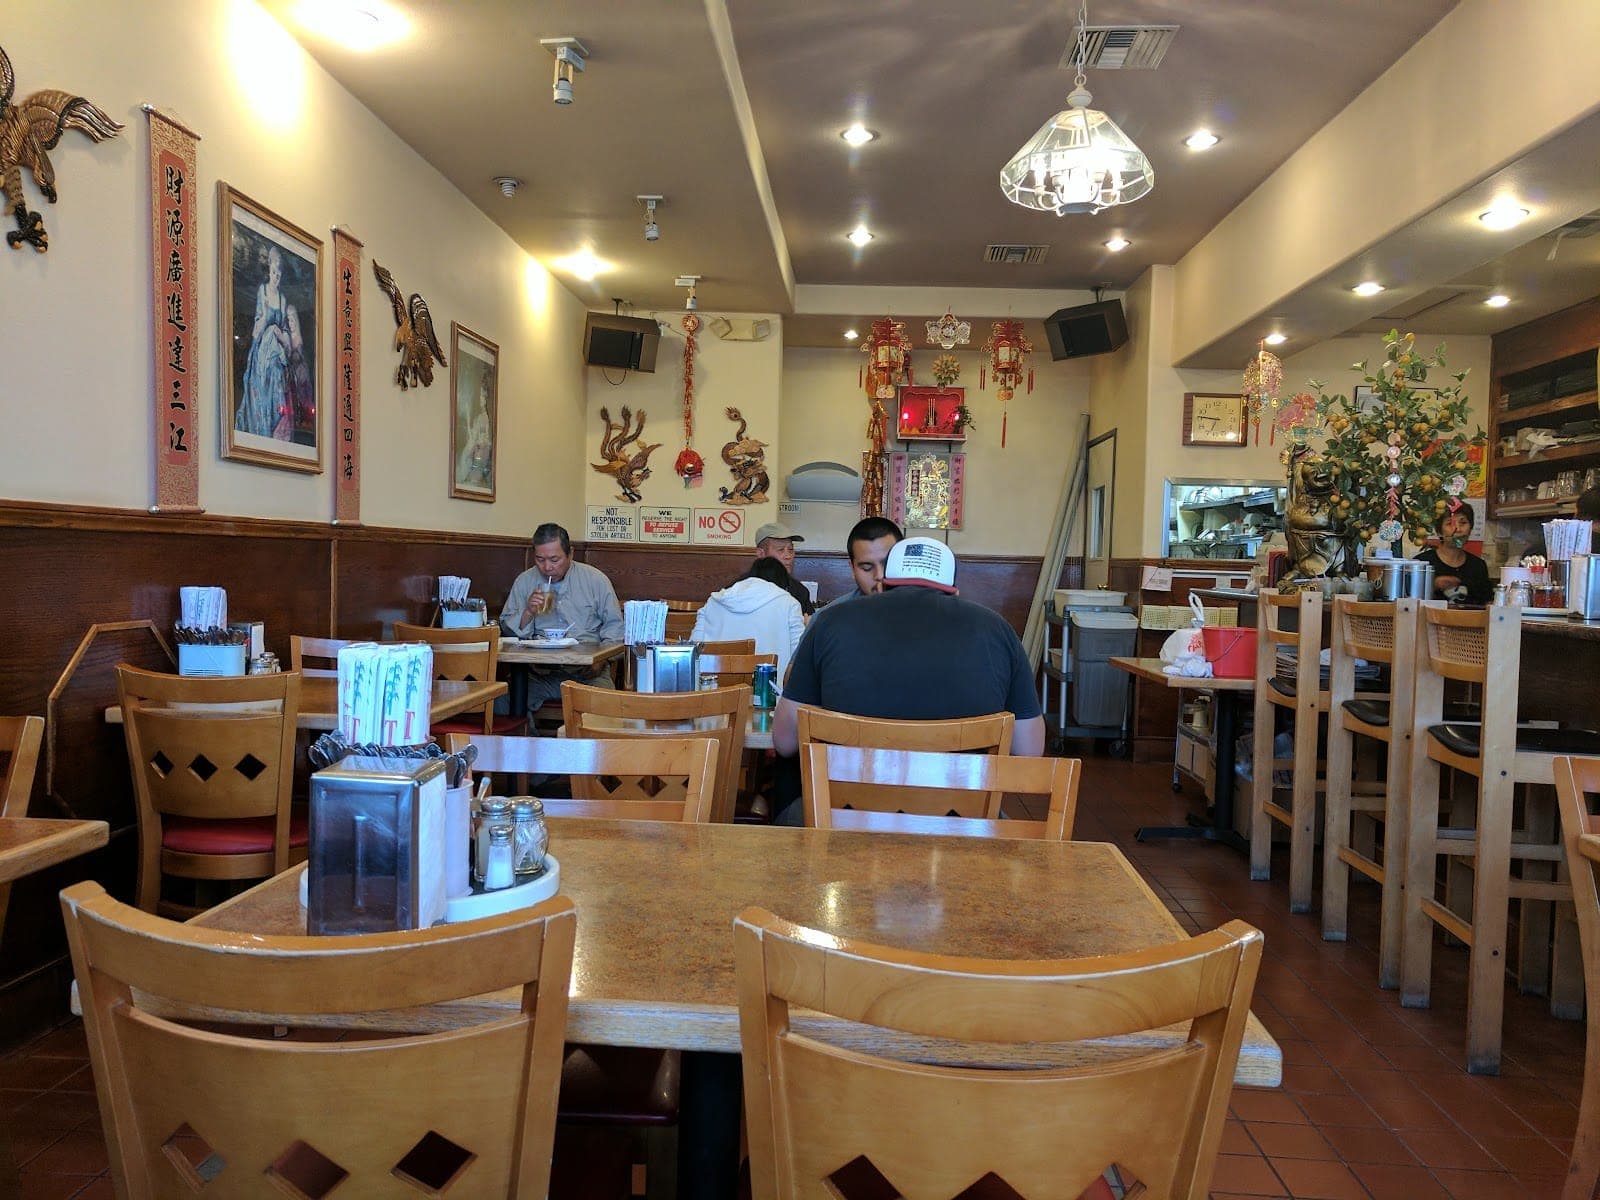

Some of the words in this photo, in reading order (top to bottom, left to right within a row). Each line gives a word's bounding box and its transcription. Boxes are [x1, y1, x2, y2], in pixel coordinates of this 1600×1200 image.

[605, 507, 618, 516] NOT
[591, 516, 633, 526] RESPONSIBLE
[698, 516, 715, 529] NO
[706, 532, 732, 540] SMOKING
